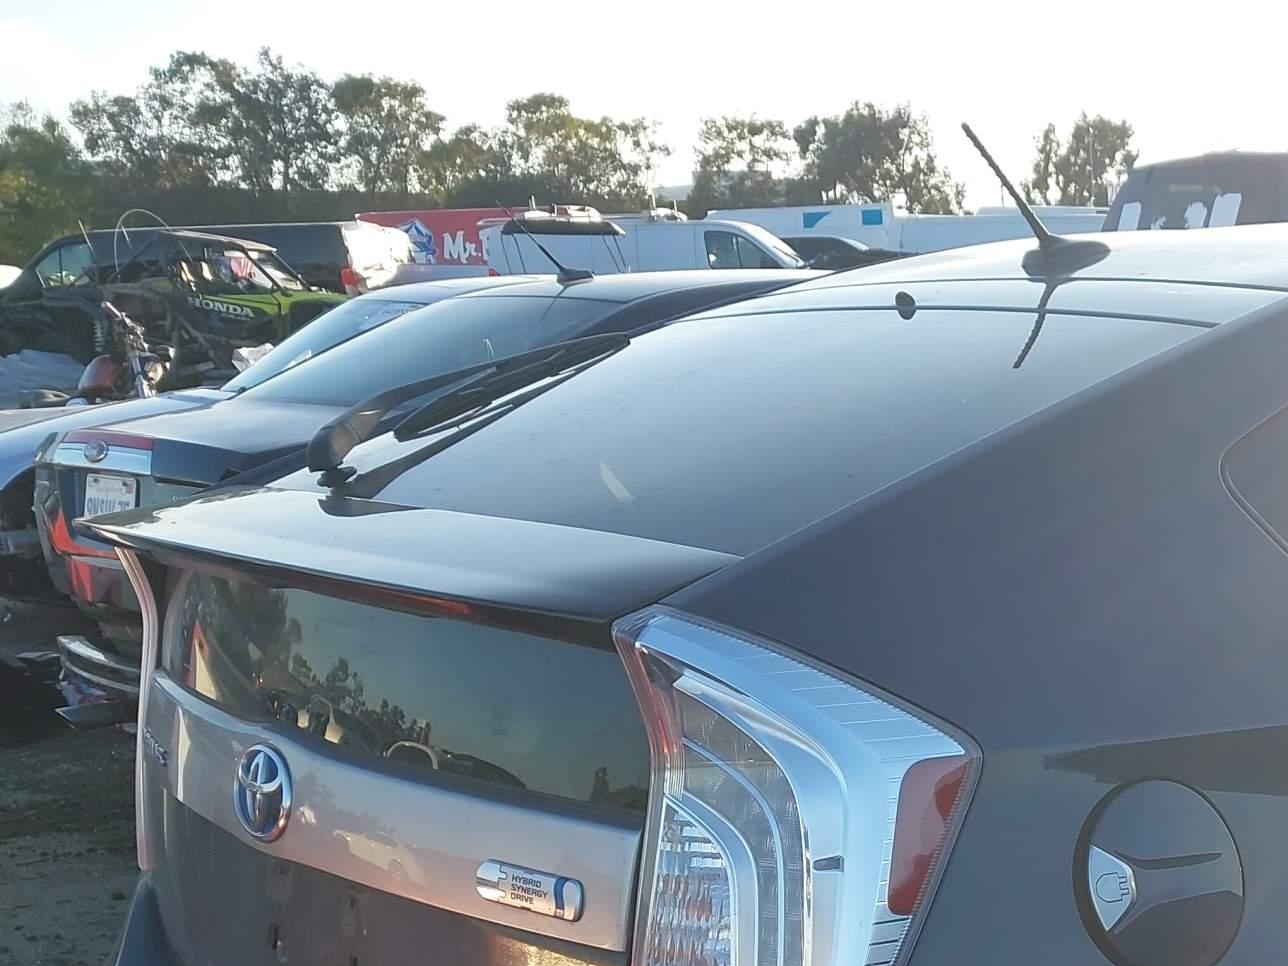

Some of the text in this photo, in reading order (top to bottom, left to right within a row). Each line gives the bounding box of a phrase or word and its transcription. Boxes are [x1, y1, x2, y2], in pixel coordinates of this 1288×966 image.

[442, 231, 481, 264] Mr.
[187, 296, 256, 318] HONDA
[511, 873, 542, 888] HYBRID
[511, 883, 548, 898] SYNERGY
[511, 892, 534, 904] DRIVE
